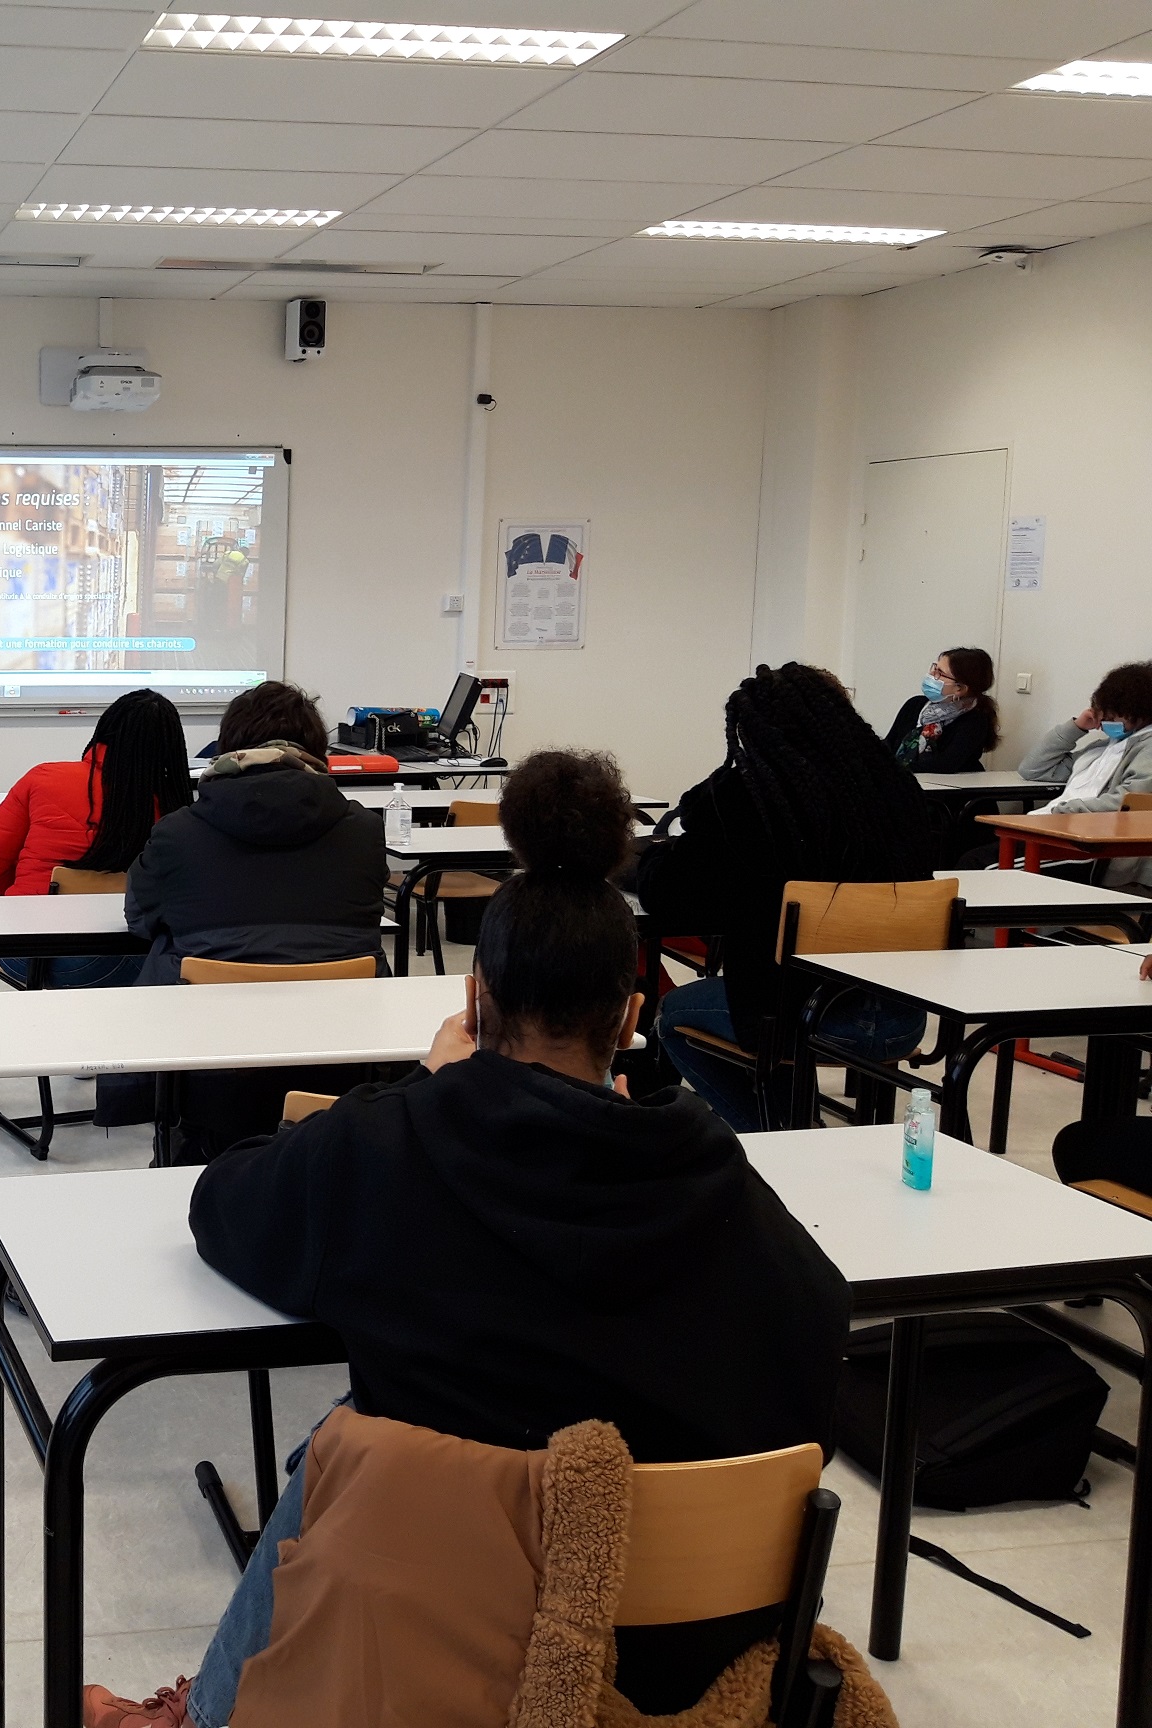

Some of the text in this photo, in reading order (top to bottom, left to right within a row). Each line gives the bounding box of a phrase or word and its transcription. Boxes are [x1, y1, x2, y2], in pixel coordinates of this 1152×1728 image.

[15, 490, 80, 509] requises
[25, 519, 63, 531] Cariste
[3, 543, 58, 558] Logistique
[6, 641, 22, 649] une
[24, 640, 67, 649] formation
[70, 641, 90, 651] pour
[92, 640, 130, 649] conduire
[132, 640, 145, 649] les
[146, 640, 184, 649] chariots.
